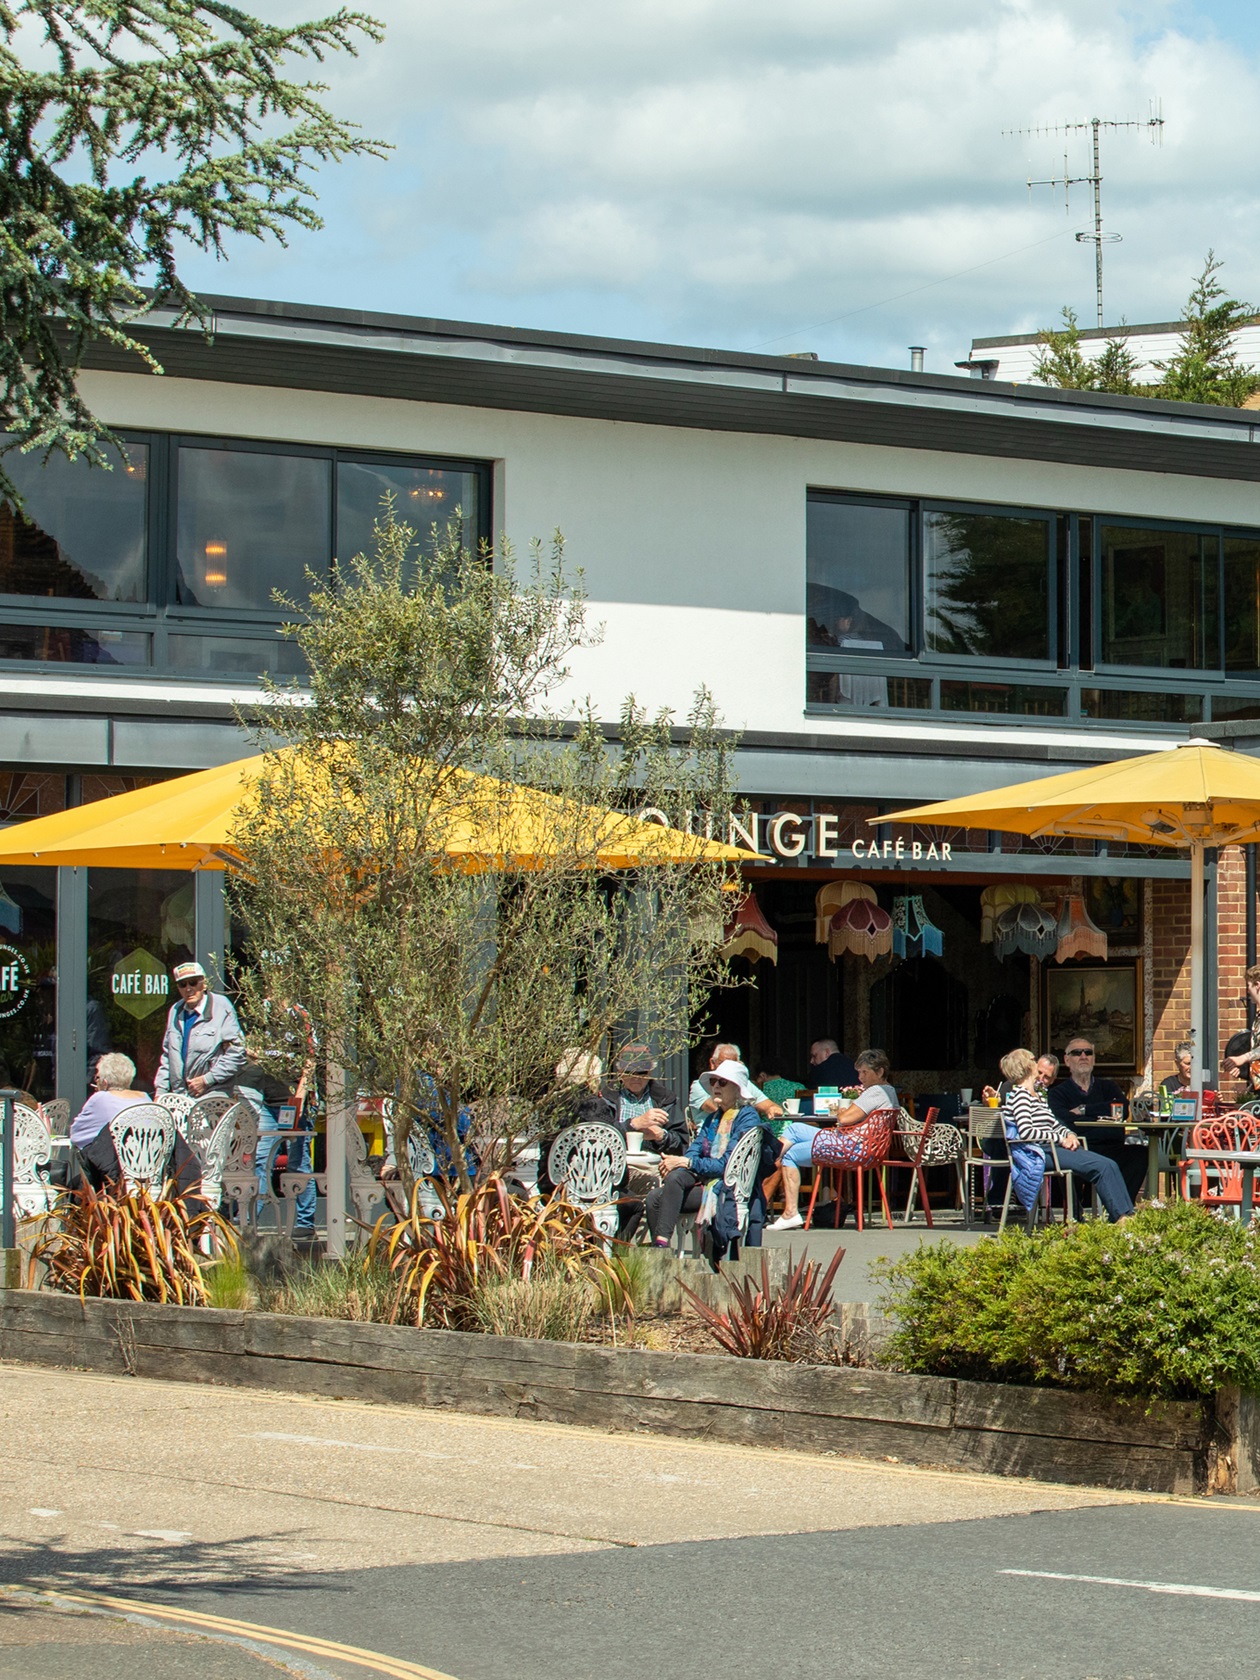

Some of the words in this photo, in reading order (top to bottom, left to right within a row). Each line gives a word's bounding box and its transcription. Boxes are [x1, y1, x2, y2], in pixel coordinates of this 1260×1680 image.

[852, 836, 905, 859] CAFÉ
[912, 842, 952, 861] BAR
[0, 960, 19, 991] FÉ
[111, 968, 141, 994] CAFÉ
[145, 974, 169, 994] BAR
